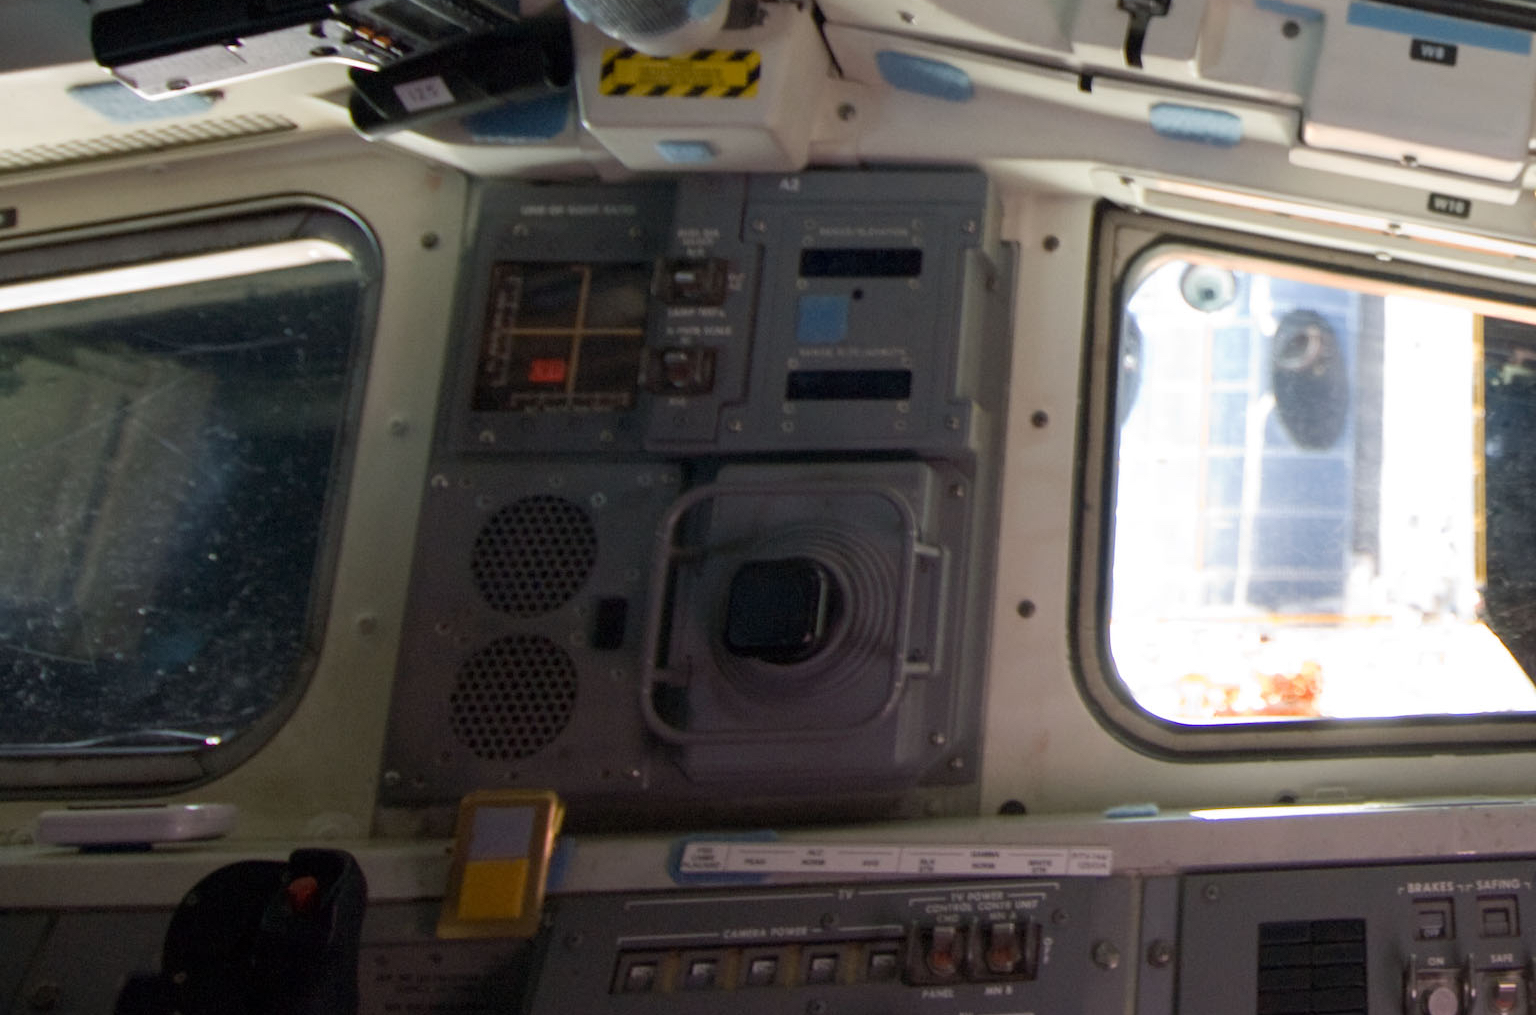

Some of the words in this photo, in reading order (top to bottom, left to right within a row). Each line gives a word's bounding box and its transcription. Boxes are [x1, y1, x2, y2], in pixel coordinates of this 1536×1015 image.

[1407, 881, 1454, 894] BRAKES
[1475, 879, 1521, 891] SAFING
[967, 891, 1005, 902] POWER
[723, 928, 768, 939] CAMERA
[770, 926, 809, 937] POWER
[1427, 957, 1444, 967] ON
[1490, 953, 1514, 964] SAFE
